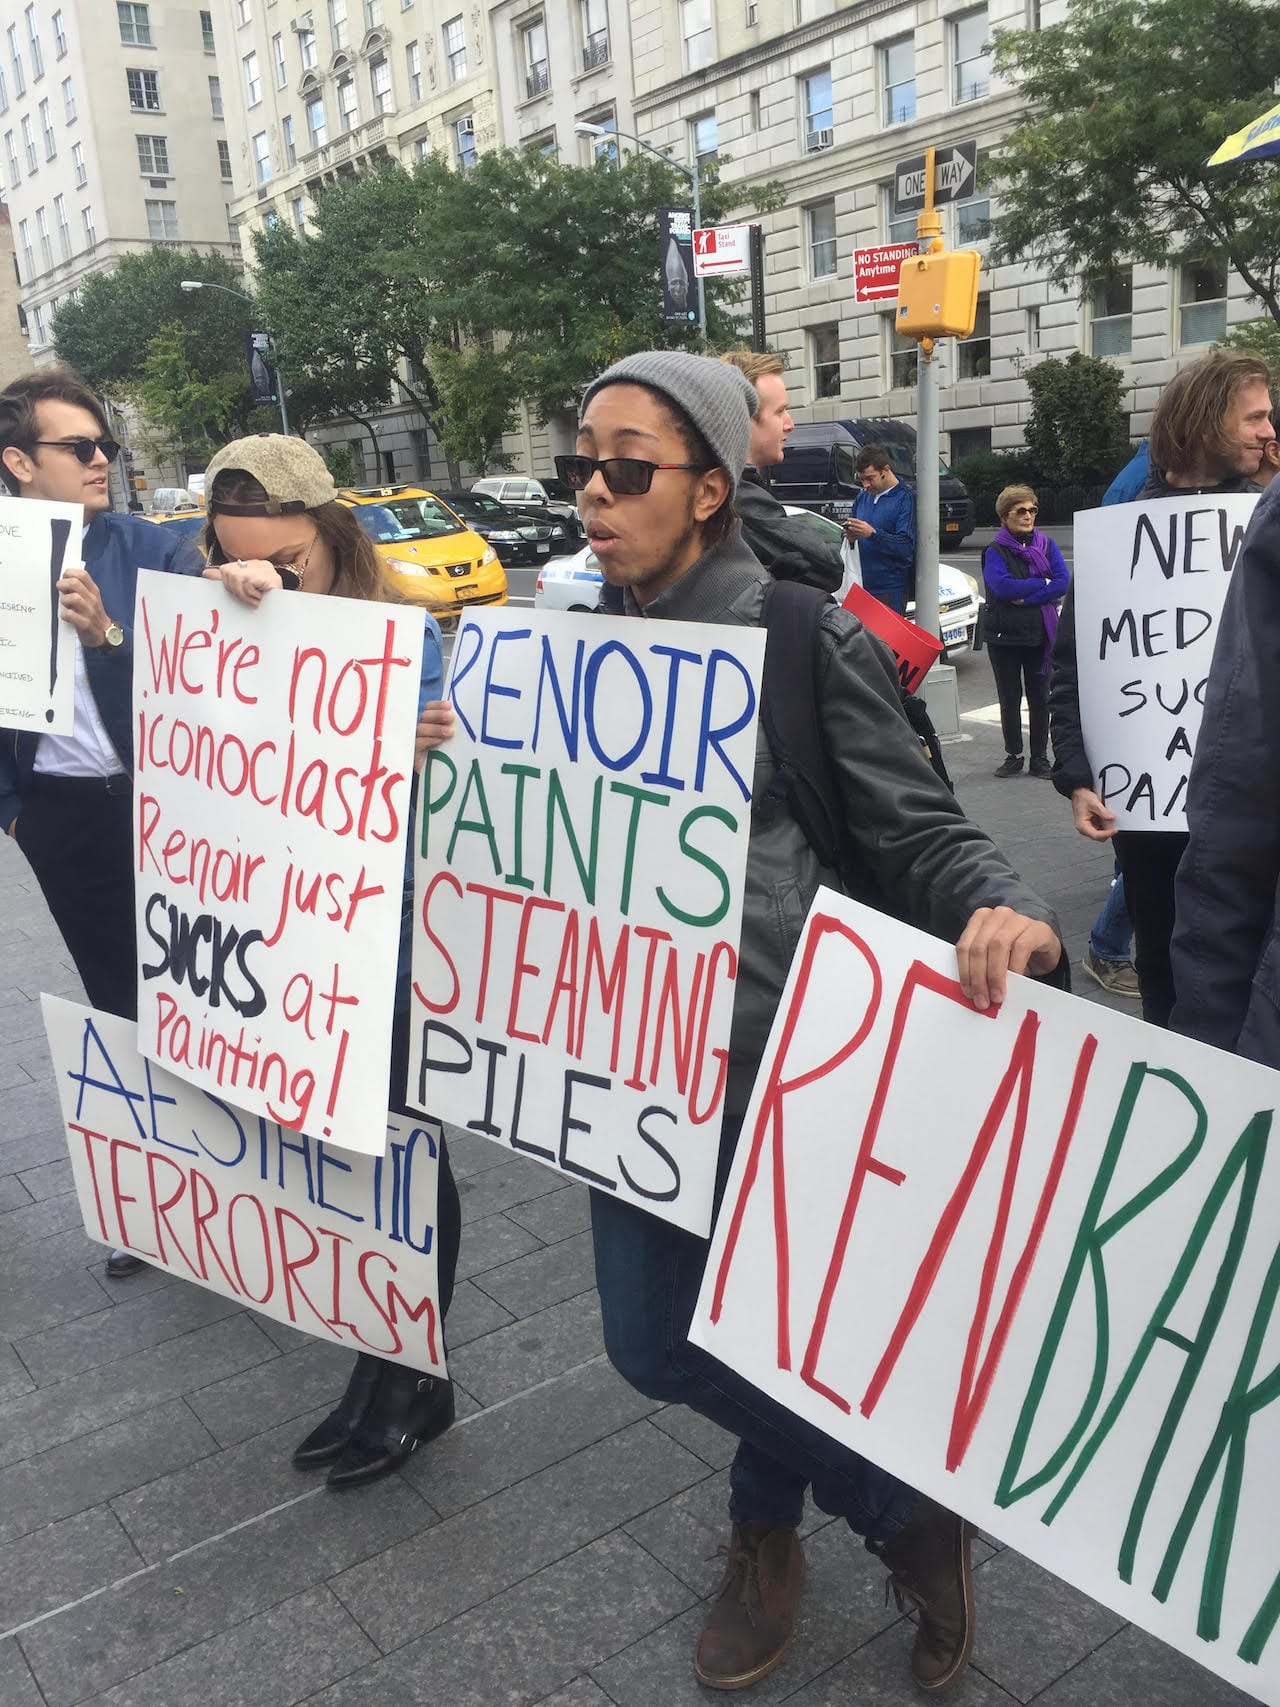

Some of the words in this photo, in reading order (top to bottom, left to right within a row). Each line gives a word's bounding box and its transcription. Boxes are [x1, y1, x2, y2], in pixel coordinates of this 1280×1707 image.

[718, 240, 736, 248] Stand
[905, 171, 926, 196] ONE
[941, 160, 965, 187] WAY
[858, 253, 871, 265] NO
[874, 247, 918, 264] STANDING
[859, 262, 897, 277] Anytime
[1131, 507, 1246, 580] NEW
[142, 596, 260, 704] We're
[288, 619, 412, 737] not
[942, 628, 962, 642] 3406
[138, 690, 405, 843] iconoclasts
[448, 623, 756, 803] RENOIR
[421, 750, 738, 928] PAINTS
[1099, 763, 1188, 821] PAI
[139, 792, 265, 906] Renoir
[262, 845, 384, 948] just
[156, 992, 349, 1137] Painting!
[283, 963, 360, 1040] at
[412, 871, 737, 1125] STEAMING
[418, 1019, 681, 1202] PILES
[68, 1123, 439, 1366] TERRORISM
[709, 911, 1280, 1666] RENBAR
